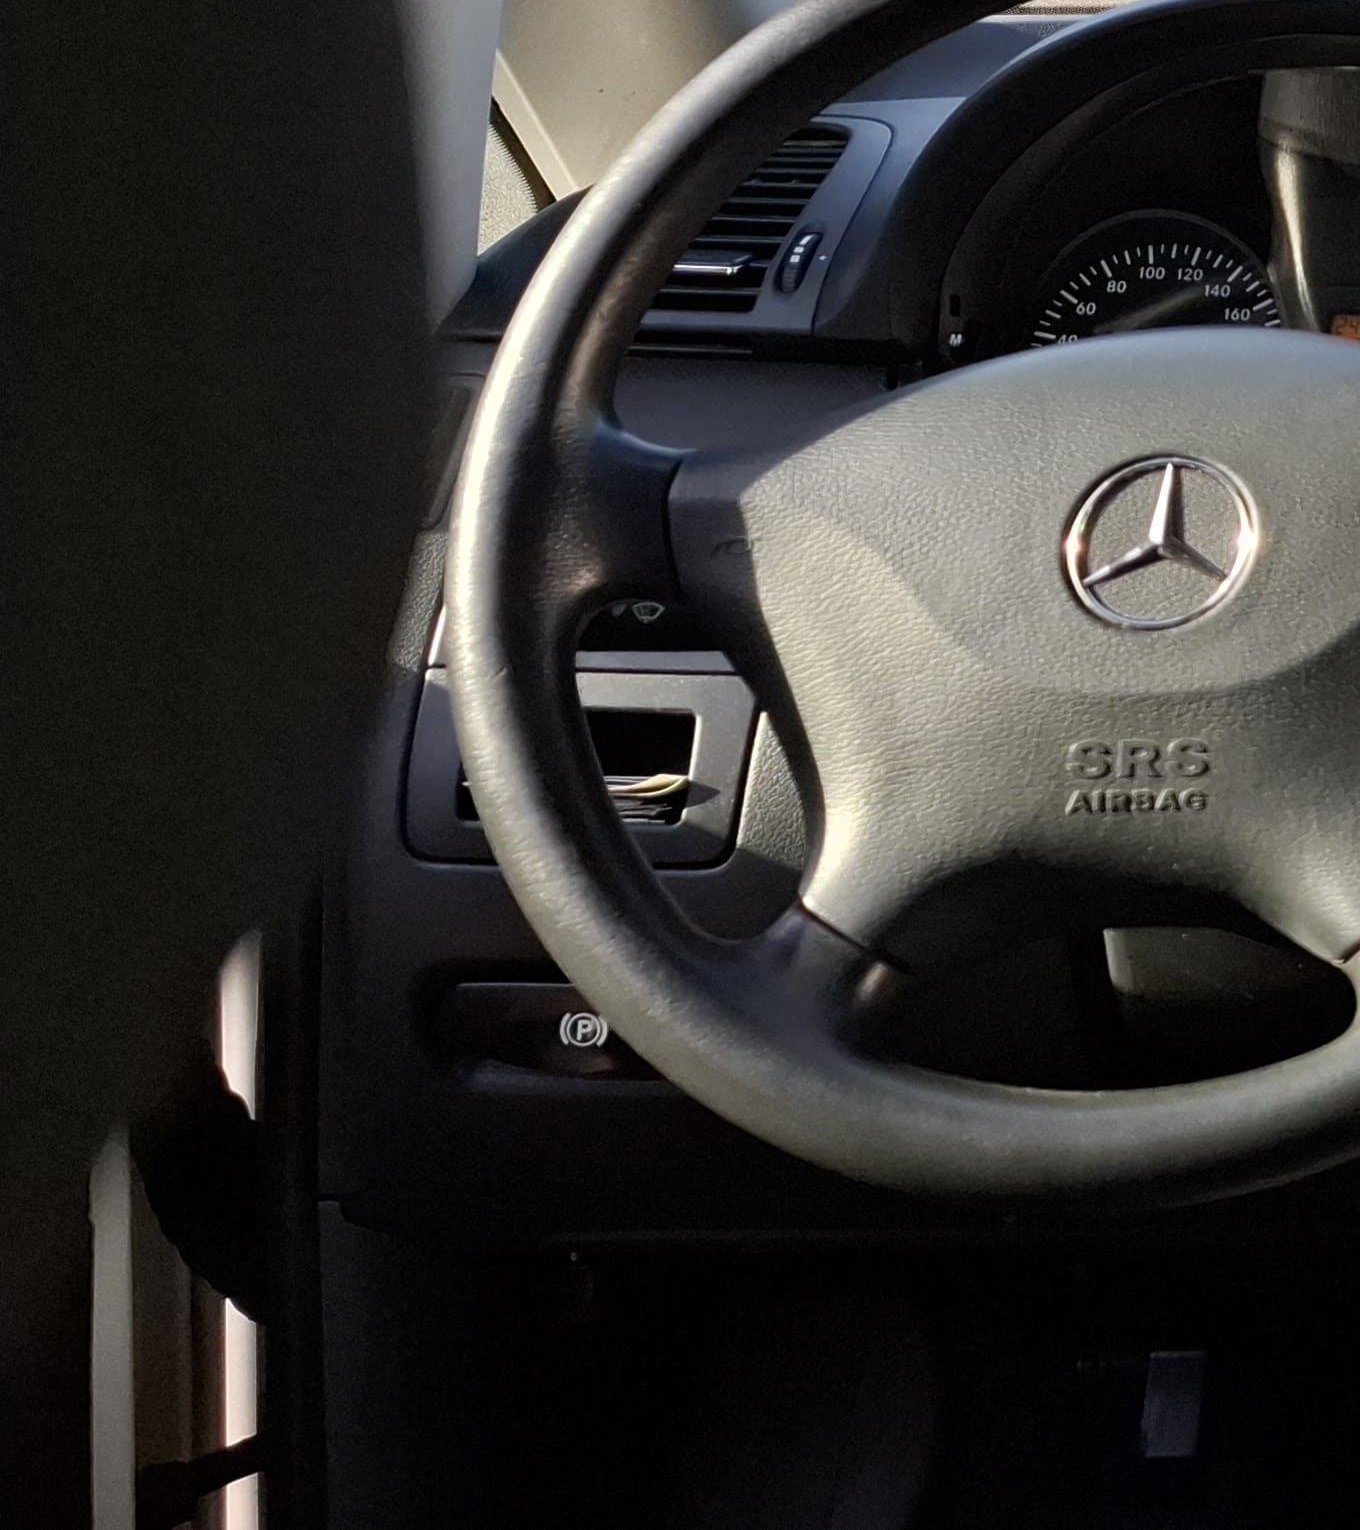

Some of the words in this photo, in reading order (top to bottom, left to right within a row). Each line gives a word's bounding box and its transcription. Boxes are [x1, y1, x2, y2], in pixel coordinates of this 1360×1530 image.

[1139, 267, 1165, 280] 100
[1177, 268, 1203, 281] 120
[1107, 281, 1127, 293] 80
[1204, 284, 1231, 297] 140
[1076, 303, 1096, 315] 60
[1224, 308, 1250, 321] 160
[1065, 738, 1210, 779] SRS
[1064, 788, 1208, 815] AIRBAG
